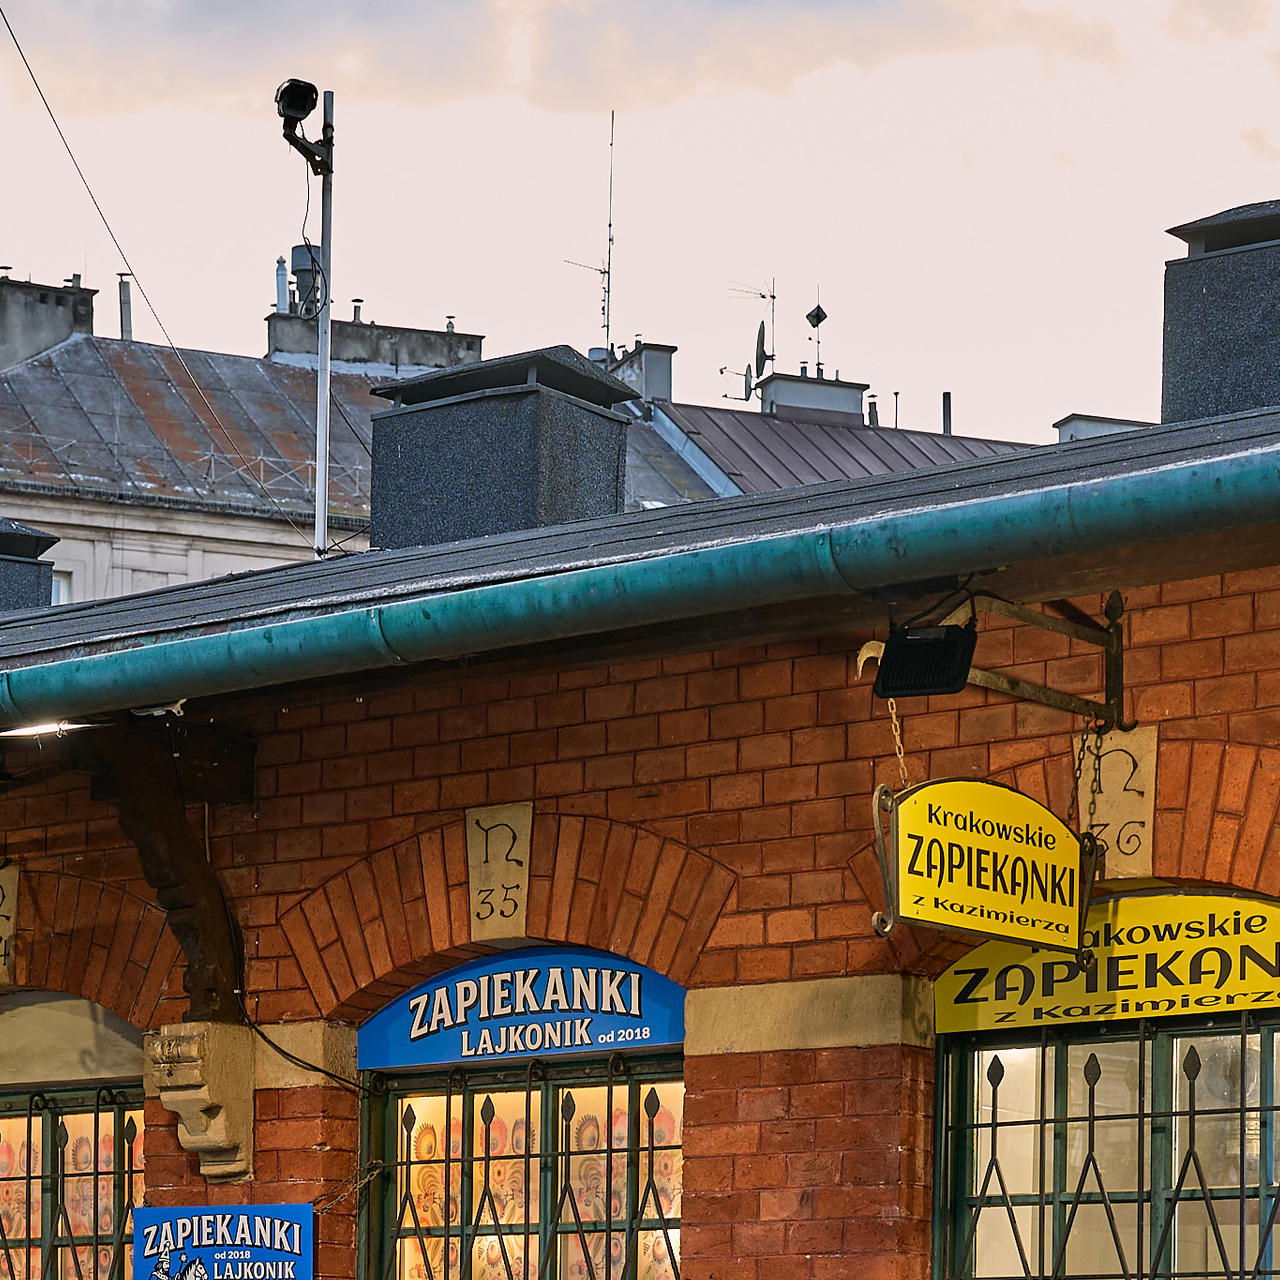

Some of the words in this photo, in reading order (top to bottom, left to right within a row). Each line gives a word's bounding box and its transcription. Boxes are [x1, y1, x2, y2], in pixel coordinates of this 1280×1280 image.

[927, 803, 1057, 851] Krakowskie
[1088, 821, 1145, 857] 36
[906, 833, 1075, 908] ZAPIEKANKI
[476, 884, 518, 920] 35
[912, 895, 925, 906] z
[933, 897, 1070, 935] Kazimierza
[1081, 910, 1268, 950] akowskie
[409, 967, 644, 1042] ZAPIEKANKI
[994, 1011, 1017, 1023] z
[460, 1018, 592, 1057] LAJKONIK
[597, 1030, 615, 1043] od
[616, 1027, 651, 1042] 2018
[143, 1214, 303, 1258] ZAPIEKANKI
[214, 1250, 226, 1259] od
[227, 1250, 251, 1260] 2018
[213, 1261, 297, 1280] LAJKONIK
